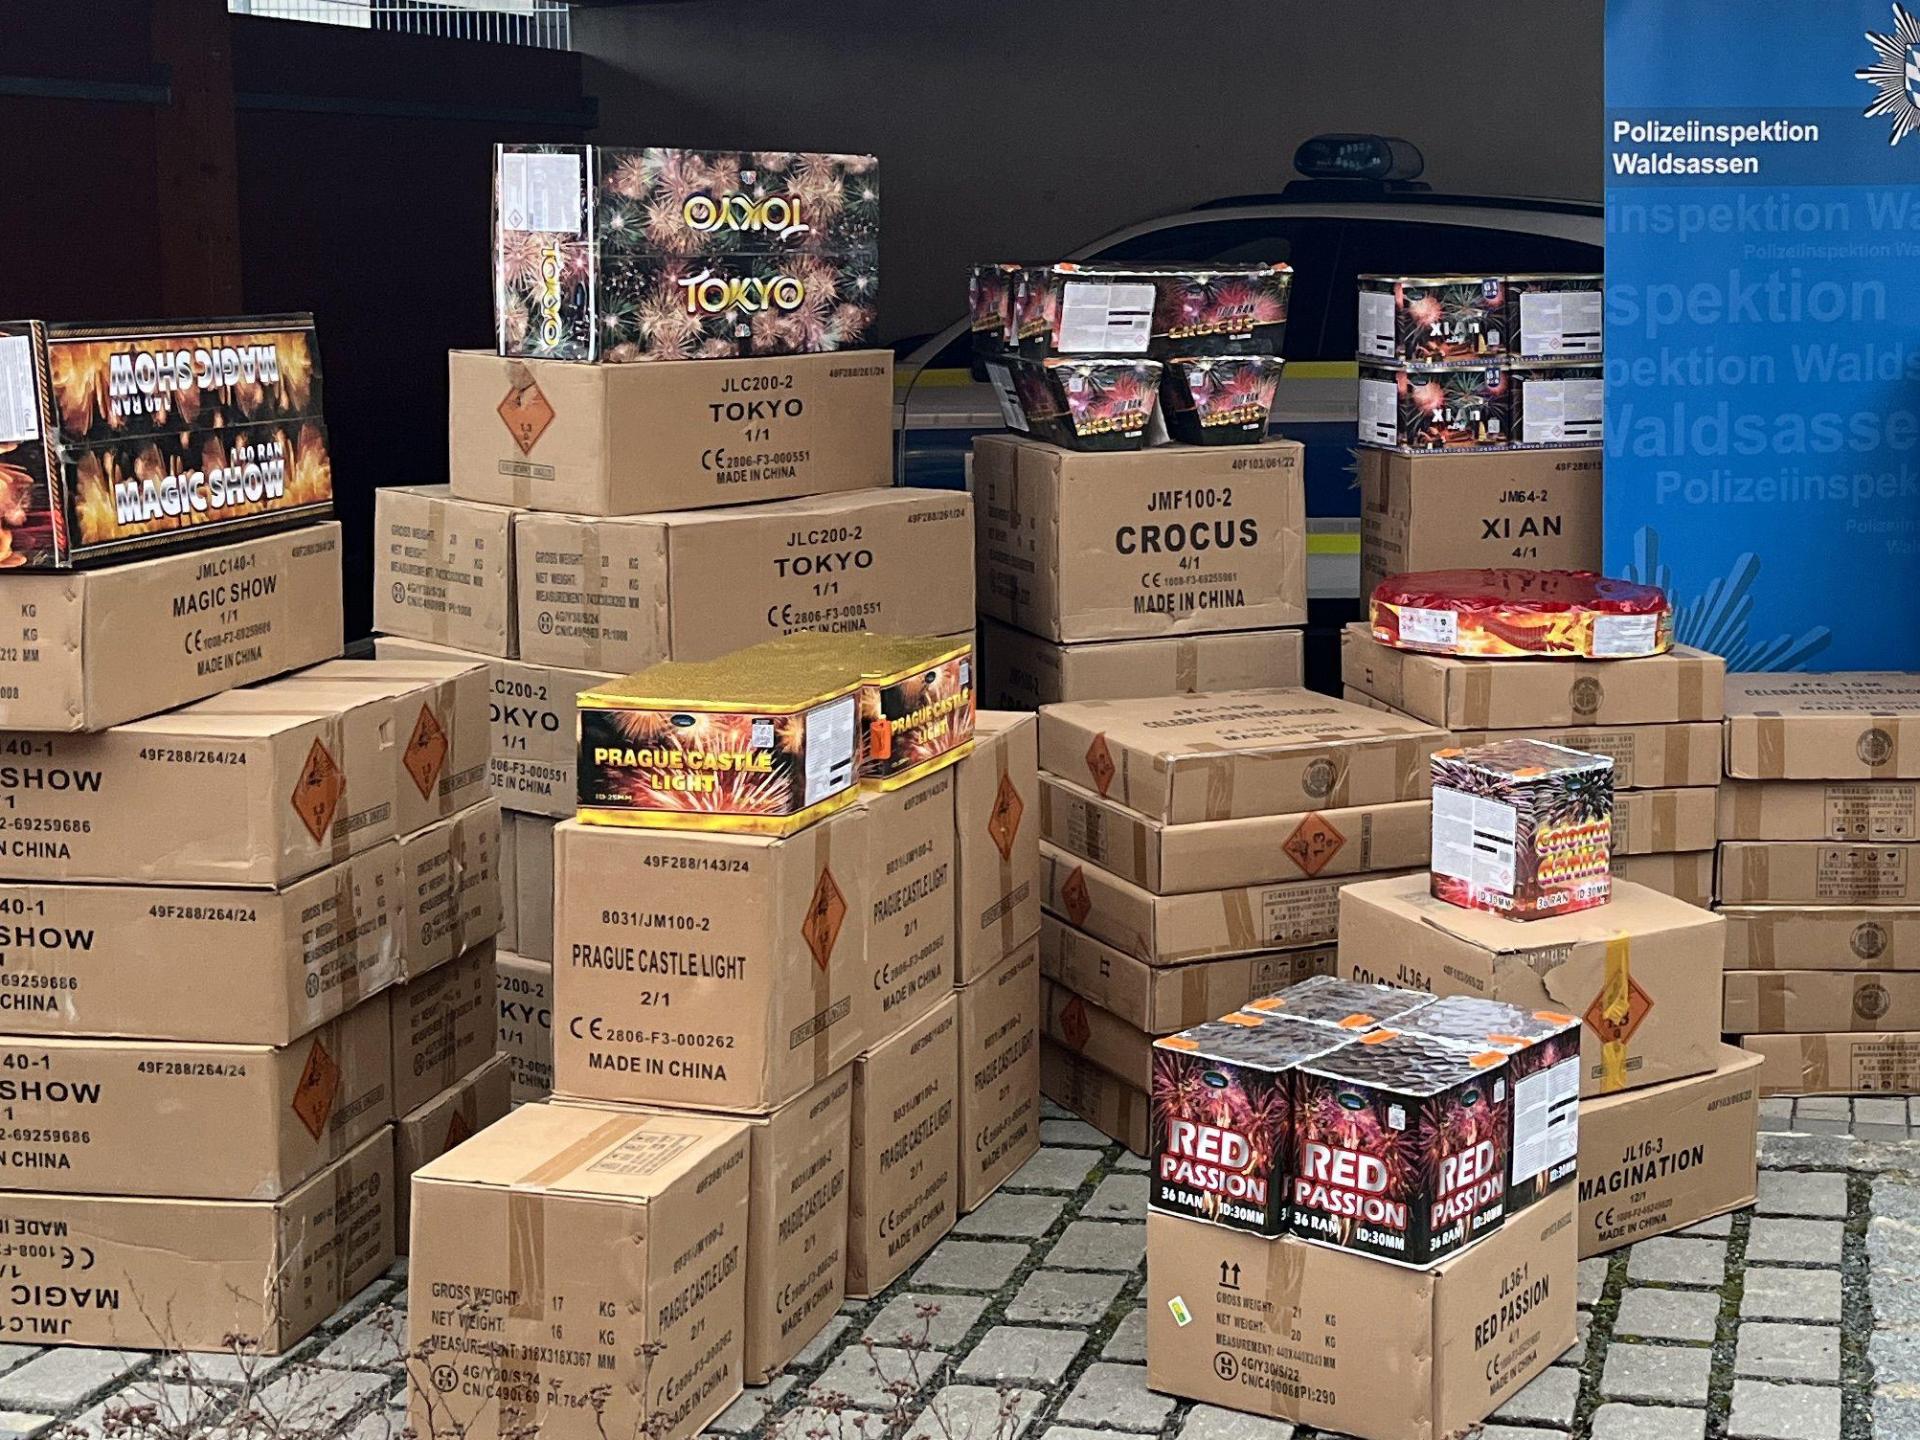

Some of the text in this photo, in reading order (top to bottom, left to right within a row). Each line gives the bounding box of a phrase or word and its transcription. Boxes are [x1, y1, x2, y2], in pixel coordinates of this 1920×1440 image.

[1613, 120, 1819, 147] Polizeiinspektion
[1612, 152, 1759, 175] Waldsassen
[682, 193, 810, 240] TOKYO
[1744, 243, 1889, 264] Polizeiinspektion
[541, 242, 563, 347] TOKYO
[678, 268, 805, 316] TOKYO
[1605, 268, 1886, 339] spektion
[109, 345, 280, 397] MAGIC SHOW
[721, 375, 794, 393] JLC200-2
[709, 398, 803, 423] TOKYO
[745, 428, 770, 442] 1/1
[256, 442, 283, 461] RAN
[716, 466, 796, 485] MADE IN CHINA
[114, 458, 285, 526] MAGIC SHOW
[1148, 488, 1232, 512] JMF100-2
[1499, 489, 1548, 504] JM64-2
[786, 526, 863, 547] JLC200-2
[1116, 519, 1259, 554] CROCUS
[773, 550, 873, 578] TOKYO
[1179, 556, 1201, 570] 4/1
[1511, 547, 1538, 559] 4/1
[173, 574, 278, 617] MAGIC SHOW
[813, 582, 839, 597] 1/1
[1134, 589, 1245, 614] MADE IN CHINA
[21, 604, 37, 618] KG
[220, 609, 239, 625] 1/1
[23, 628, 38, 641] KG
[831, 618, 867, 635] CHINA
[197, 645, 263, 677] MADE CHINA
[890, 704, 934, 735] PRAGUE
[502, 734, 526, 751] 1/1
[139, 748, 247, 765] 49F288/264/24
[594, 748, 773, 773] PRAGUE CASTLE
[0, 767, 103, 793] SHOW
[518, 778, 553, 797] CHINA
[651, 773, 717, 793] LIGHT
[12, 841, 72, 860] CHINA
[643, 854, 750, 873] 49F288/143/24
[873, 863, 948, 926] PRAGUE CASTLE LIGHT
[149, 904, 256, 922] 49F288/264/24
[602, 910, 711, 932] 8031/JM100-2
[0, 925, 95, 951] SHOW
[904, 918, 919, 938] 2/1
[572, 943, 747, 981] PRAGUE CASTLE LIGHT
[883, 963, 942, 1013] MADE CHINA
[1396, 963, 1432, 993] JL36-4
[0, 993, 59, 1012] CHINA
[640, 991, 670, 1007] 2/1
[499, 1028, 523, 1045] 1/1
[606, 1028, 735, 1049] 2806-F3-000262
[137, 1060, 246, 1078] 49F288/264/24
[589, 1052, 728, 1082] MADE IN CHINA
[0, 1080, 101, 1104] SHOW
[879, 1099, 952, 1175] PRAGUE CASTLE LIGHT
[1169, 1117, 1251, 1169] RED
[12, 1151, 71, 1169] CHINA
[1622, 1137, 1664, 1164] JL16-3
[1162, 1156, 1267, 1204] PASSION
[1302, 1141, 1389, 1194] RED
[1438, 1140, 1496, 1199] RED
[1578, 1144, 1705, 1204] MAGINATION
[1161, 1186, 1266, 1226] 36 RAN ID:30MM
[1295, 1180, 1407, 1229] PASSION
[1431, 1174, 1505, 1231] PASSION
[15, 1219, 68, 1237] MADE
[888, 1199, 945, 1258] MADE CHINA
[1294, 1211, 1406, 1251] 36 RAN ID:30MM
[1430, 1226, 1463, 1252] 36 RAN
[1598, 1213, 1668, 1242] MADE IN CHINA
[659, 1245, 739, 1333] PRAGUE CASTLE LIGHT
[1499, 1261, 1529, 1300] JL36-1
[11, 1285, 119, 1310] MAGIC
[431, 1282, 616, 1318] GROSS 17 KG
[1216, 1291, 1242, 1308] GROSS
[1325, 1313, 1337, 1327] KG
[1474, 1312, 1498, 1352] RED
[1500, 1273, 1550, 1332] PASSION
[431, 1310, 616, 1346] NET 16 KG
[1216, 1312, 1231, 1326] NET
[1291, 1329, 1302, 1342] 20
[1325, 1335, 1336, 1349] KG
[597, 1354, 617, 1371] MM
[1323, 1356, 1336, 1369] MM
[701, 1363, 729, 1400] CHINA
[1489, 1369, 1509, 1397] MADE
